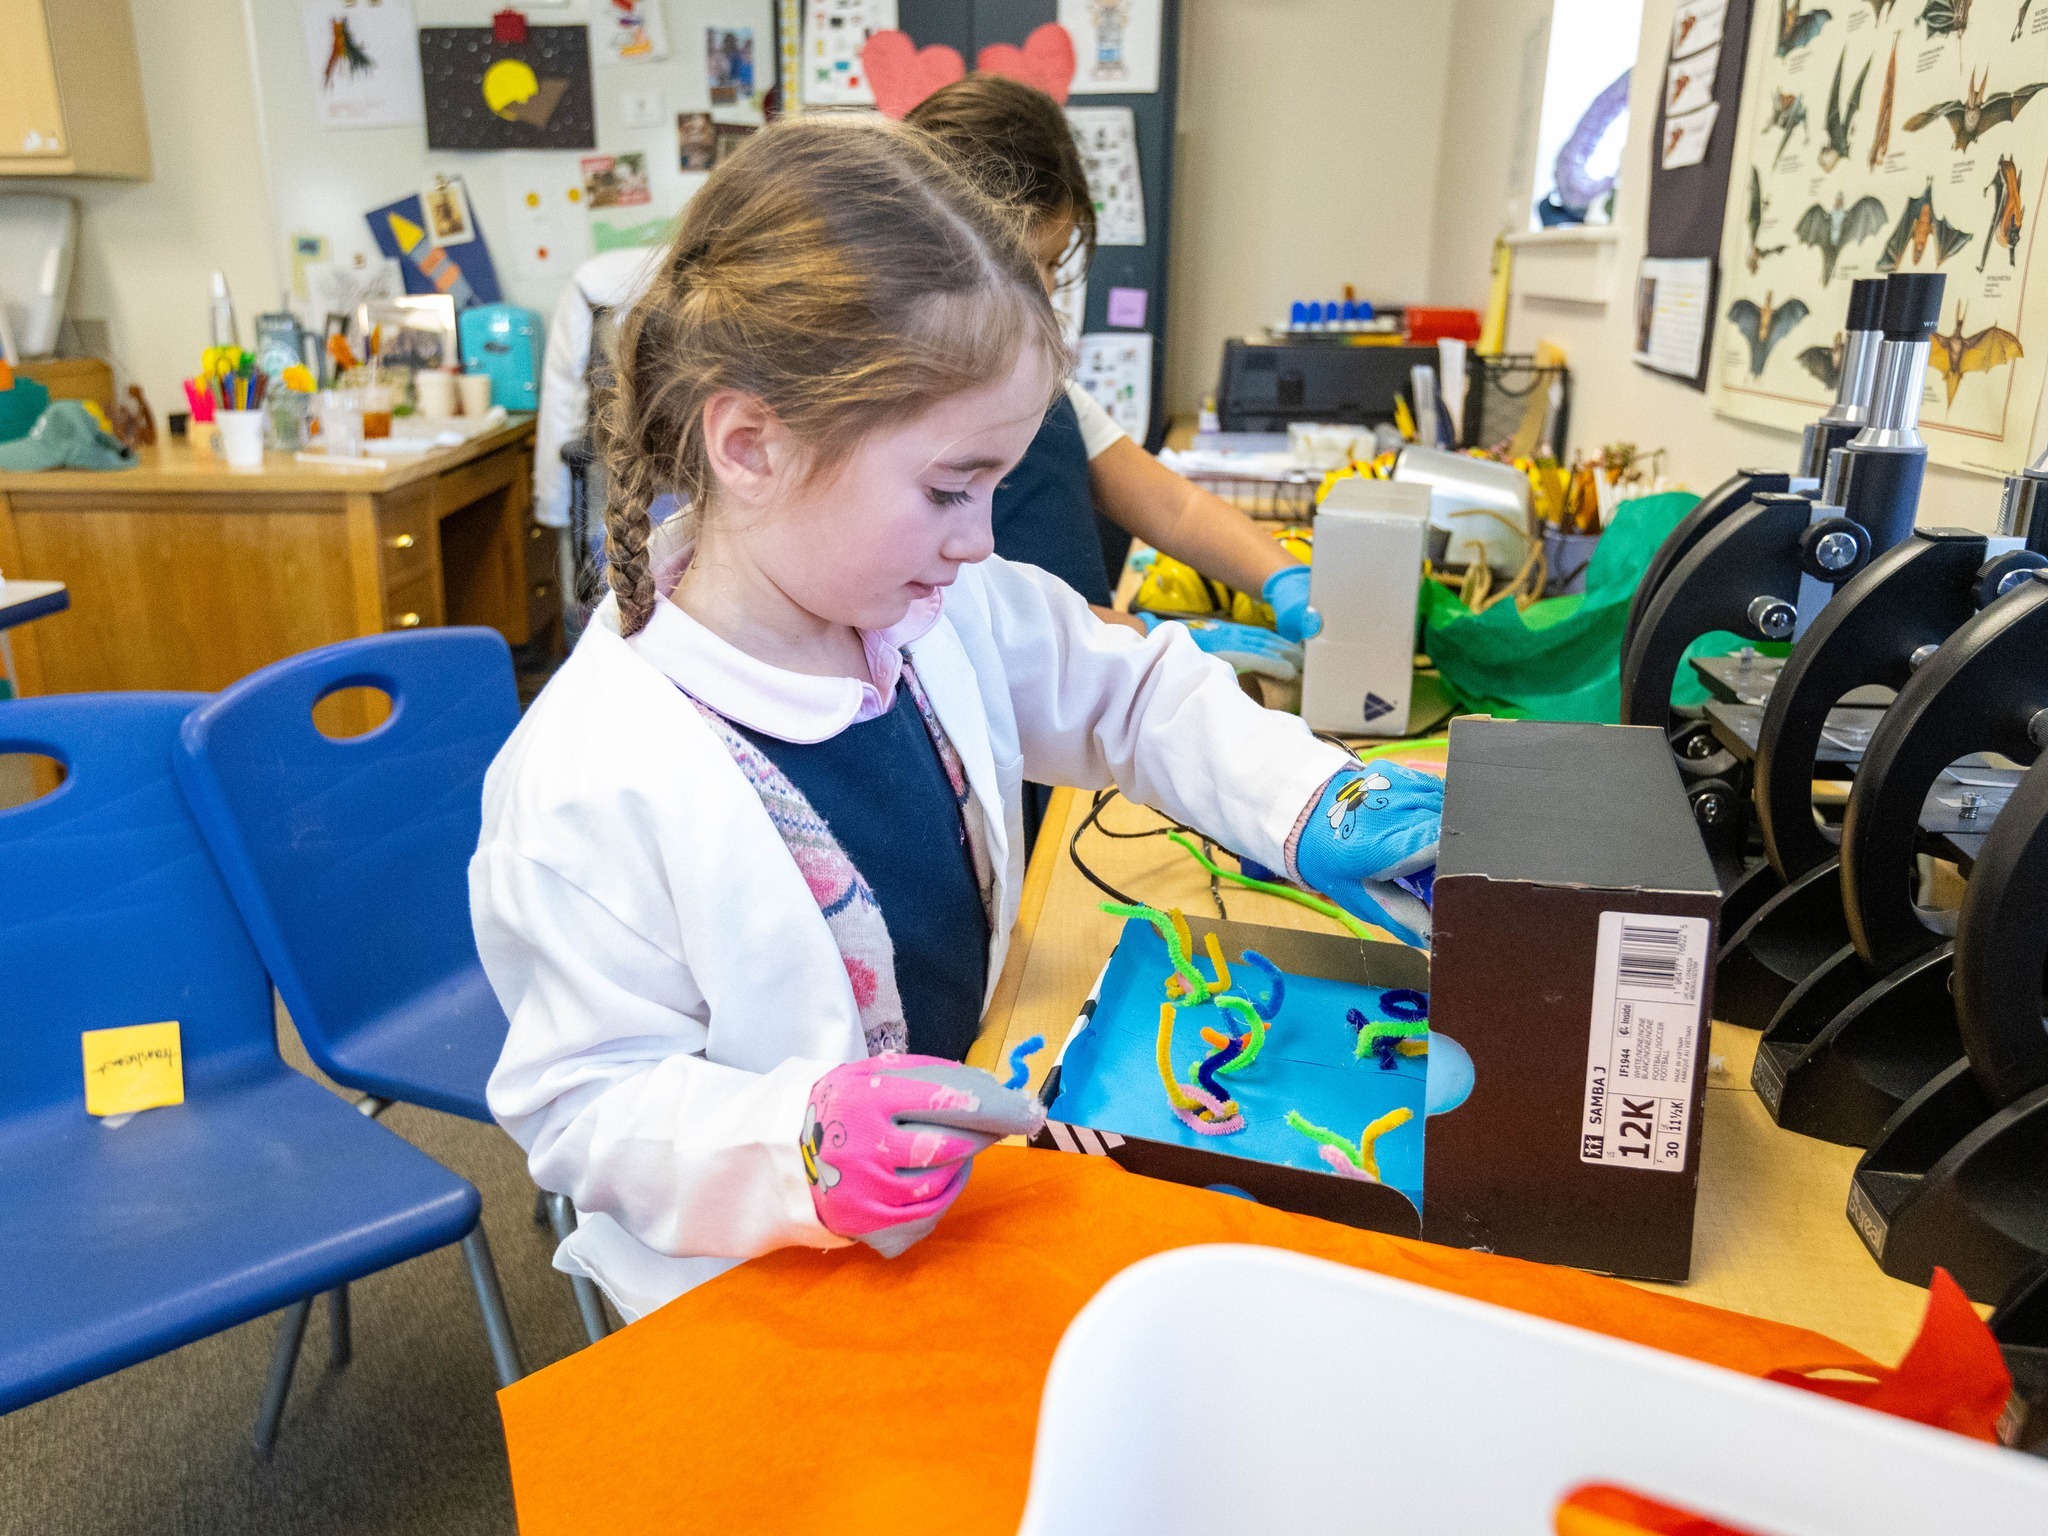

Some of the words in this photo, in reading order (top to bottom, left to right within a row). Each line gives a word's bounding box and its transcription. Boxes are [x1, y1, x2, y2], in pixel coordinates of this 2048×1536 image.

[1621, 1004, 1632, 1024] Inside
[1619, 1048, 1631, 1078] IF1944
[1652, 1022, 1665, 1081] FOOTBALL/SOCCER
[1660, 1050, 1670, 1081] FOOTBALL
[1594, 1066, 1606, 1074] J
[1589, 1078, 1606, 1124] SAMBA
[1618, 1096, 1654, 1159] 12K
[1666, 1141, 1680, 1159] 30
